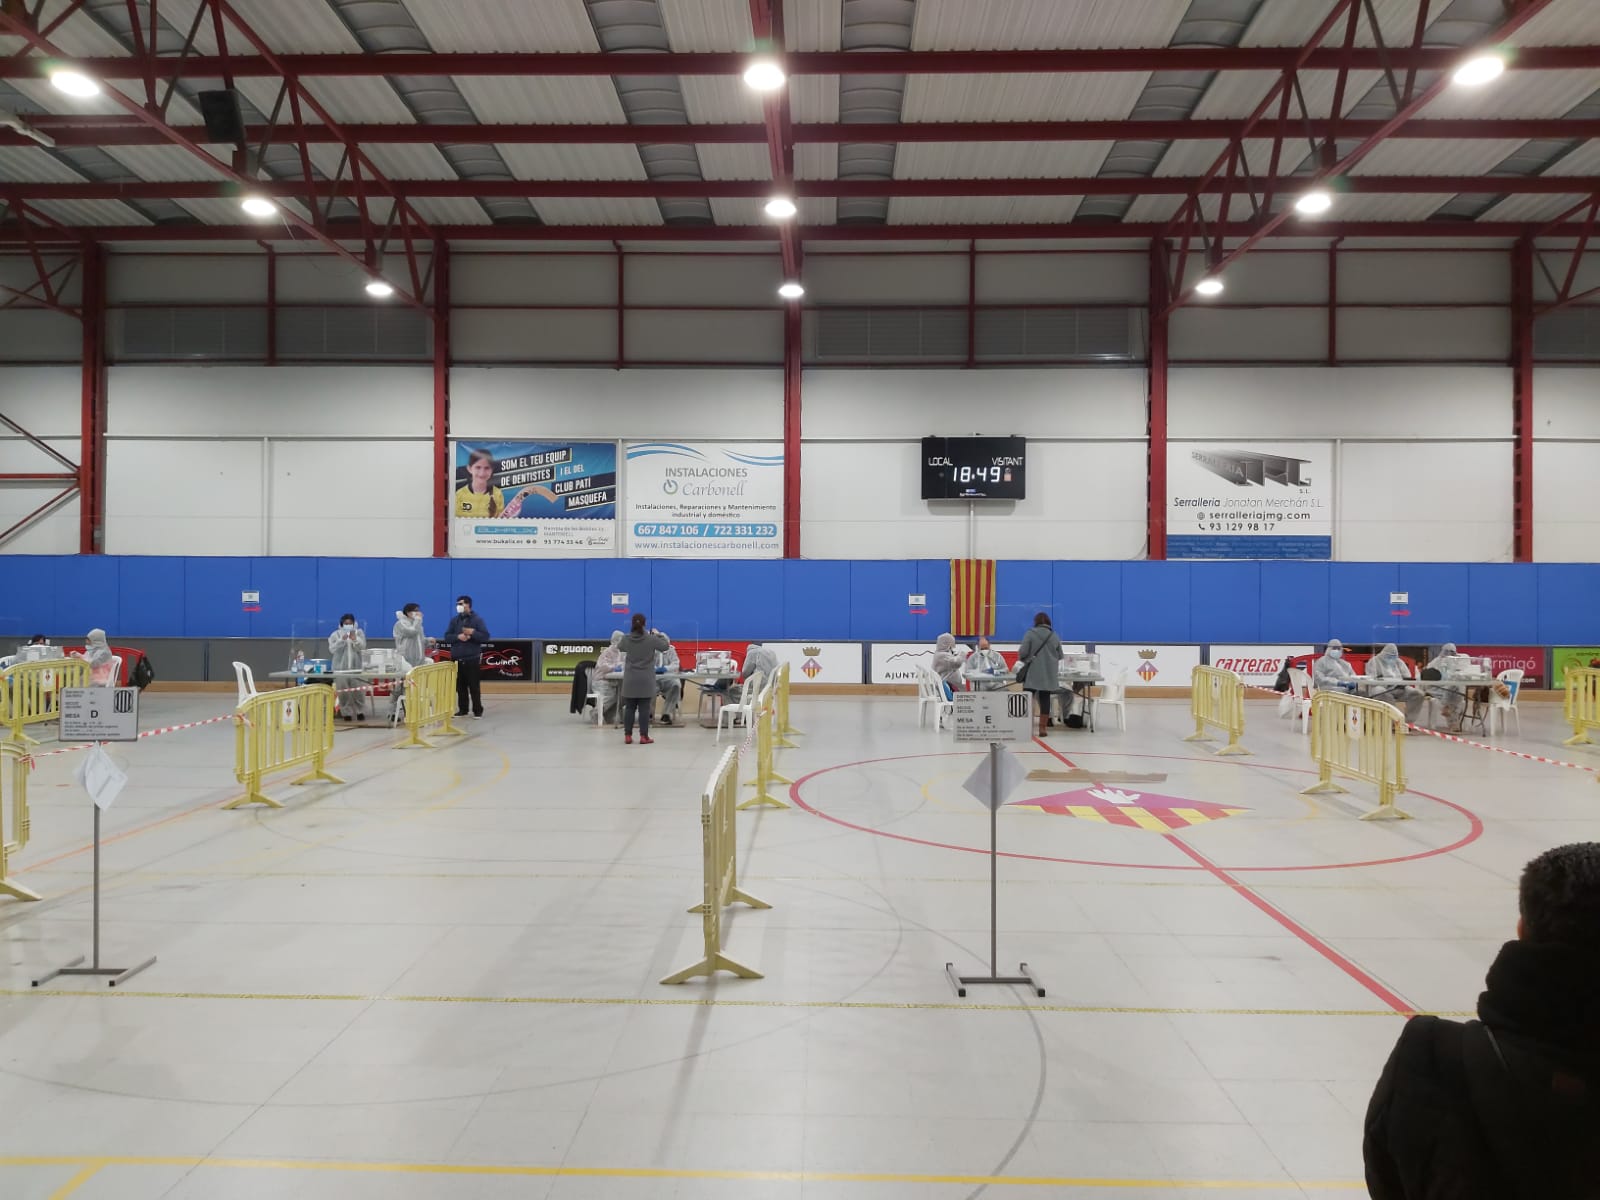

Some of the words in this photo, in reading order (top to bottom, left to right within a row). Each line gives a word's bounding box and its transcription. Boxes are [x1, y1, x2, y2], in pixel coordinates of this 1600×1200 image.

[501, 459, 518, 471] SOM
[519, 457, 529, 467] EL
[530, 454, 544, 465] TEU
[545, 450, 567, 464] EQUIP
[928, 457, 953, 466] LOCAL
[564, 465, 572, 475] EL
[573, 464, 584, 473] DEL
[665, 467, 748, 478] INSTALACIONES
[501, 476, 511, 487] DE
[512, 468, 551, 485] DENTISTES
[555, 481, 574, 494] CLUB
[682, 480, 746, 496] Carbonell
[568, 491, 607, 507] MASQUEFA
[1223, 498, 1263, 508] Jonatan
[680, 503, 721, 511] Reparaciones
[728, 503, 777, 511] Mantenimiento
[1209, 511, 1311, 521] serralleriajmg.com
[638, 525, 656, 535] 667
[658, 525, 678, 535] 847
[680, 525, 699, 535] 106
[703, 524, 709, 536] /
[714, 525, 731, 536] 722
[735, 525, 753, 536] 331
[755, 525, 774, 536] 232
[1209, 523, 1221, 531] 93
[1226, 523, 1243, 531] 129
[1247, 523, 1259, 531] 98
[1264, 523, 1275, 531] 17
[634, 540, 779, 550] www.instalacionescarbonell.com
[1215, 658, 1281, 674] carreras
[1492, 656, 1536, 670] rmigó
[885, 672, 919, 680] AJUNT
[90, 710, 99, 719] D
[984, 715, 992, 724] E
